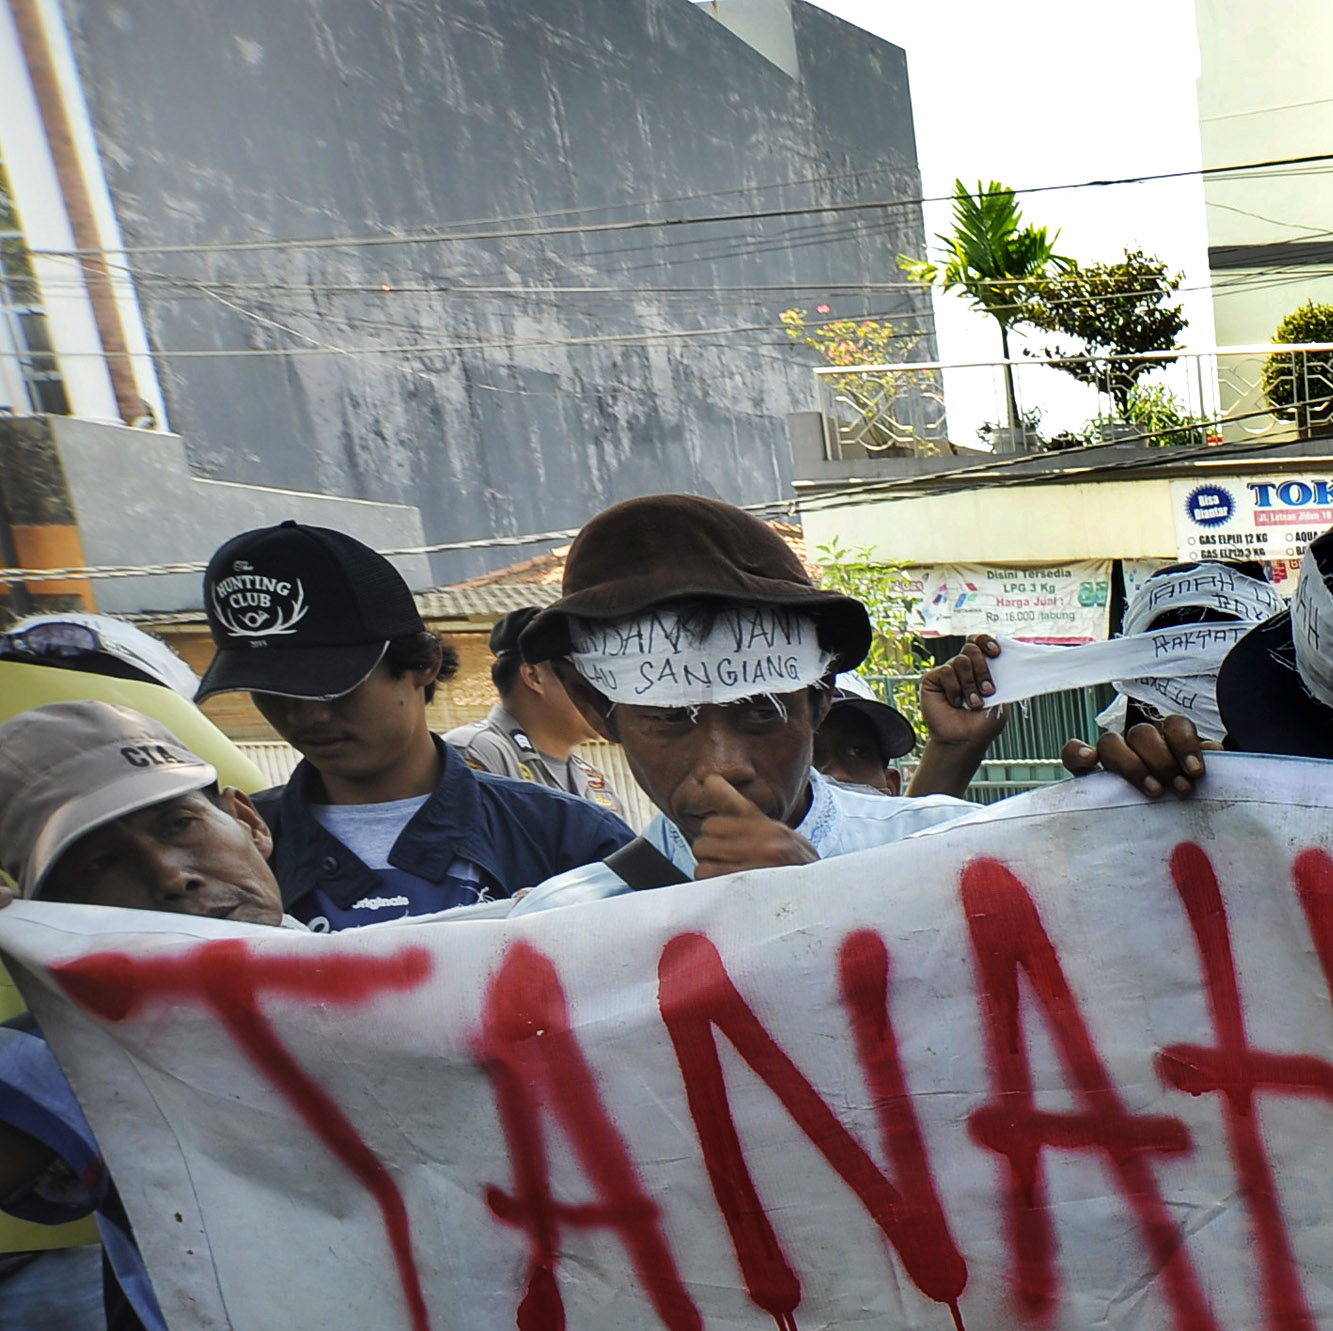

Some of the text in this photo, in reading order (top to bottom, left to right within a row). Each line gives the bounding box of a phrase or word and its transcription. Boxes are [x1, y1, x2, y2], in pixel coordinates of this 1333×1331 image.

[1199, 535, 1216, 545] GAS
[1256, 533, 1268, 543] KG
[1201, 549, 1218, 559] GAS
[987, 568, 1072, 580] Disini Tersedia
[216, 574, 292, 599] HUNTING
[1003, 583, 1056, 594] LPG 3 Kg
[229, 592, 271, 609] CLUB
[996, 597, 1030, 608] Harga
[1034, 596, 1057, 606] Jual
[635, 655, 801, 695] SANGIANG
